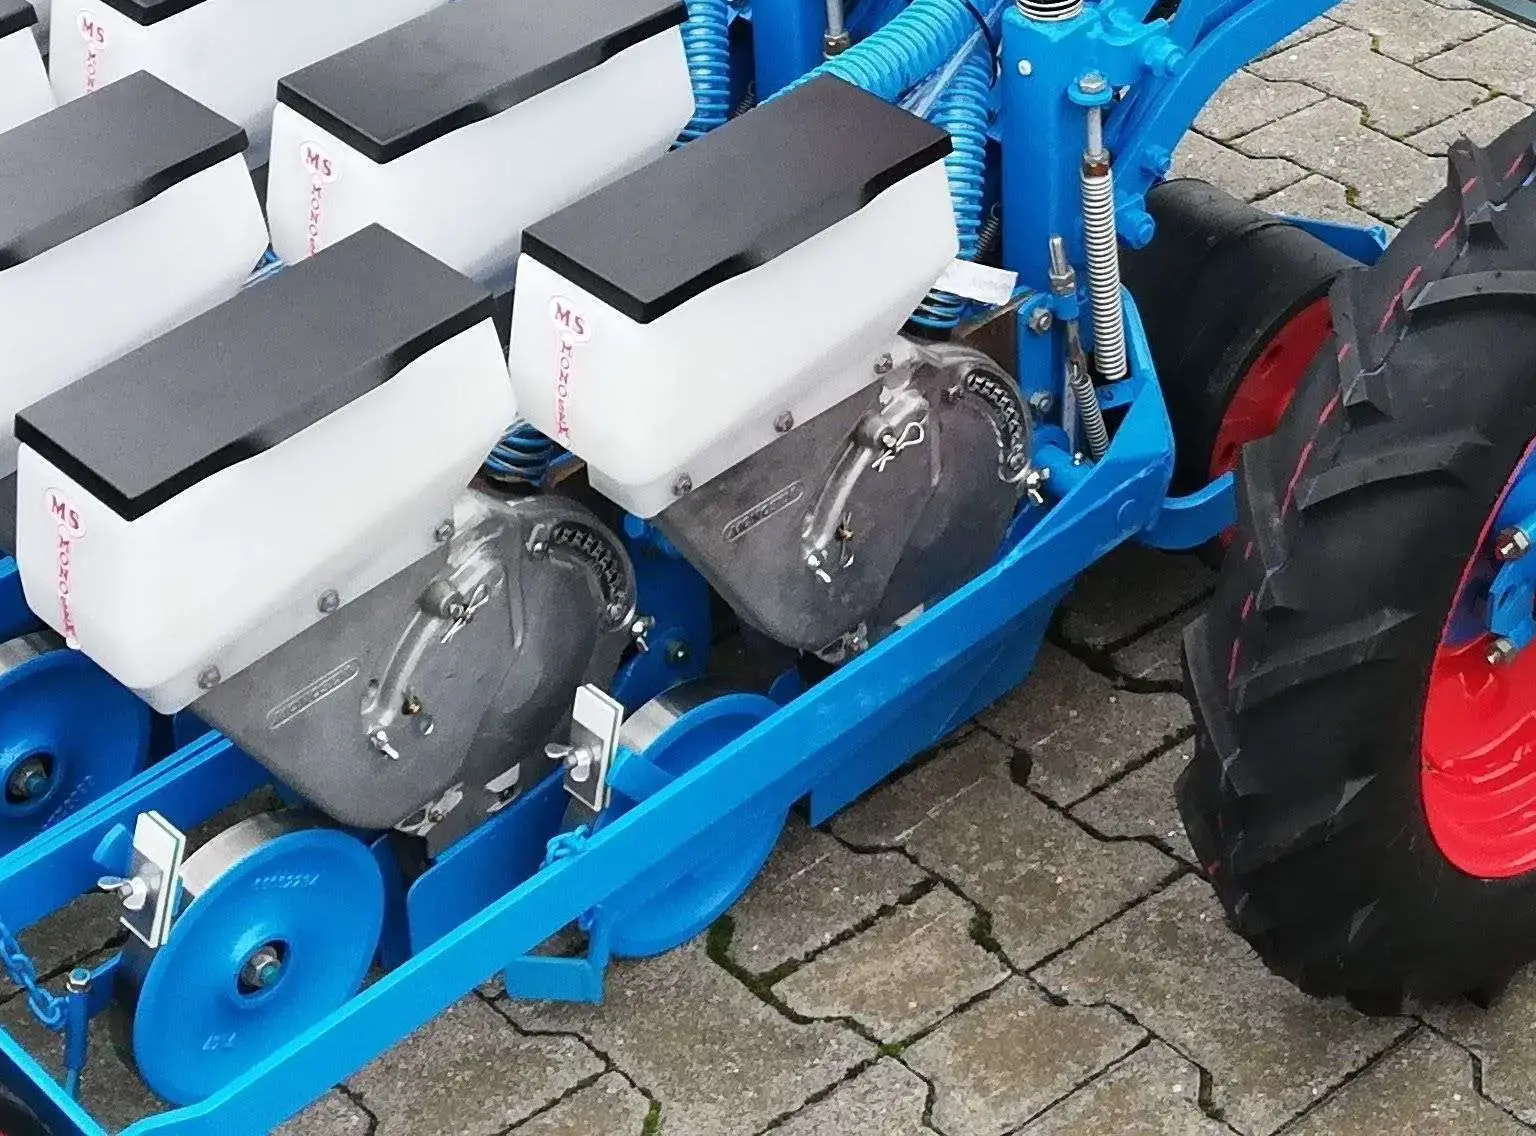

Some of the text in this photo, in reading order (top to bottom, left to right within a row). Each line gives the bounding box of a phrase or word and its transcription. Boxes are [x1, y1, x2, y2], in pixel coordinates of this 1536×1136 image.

[81, 15, 105, 44] MS
[305, 145, 333, 177] MS
[554, 301, 586, 335] MS
[51, 494, 81, 531] MS
